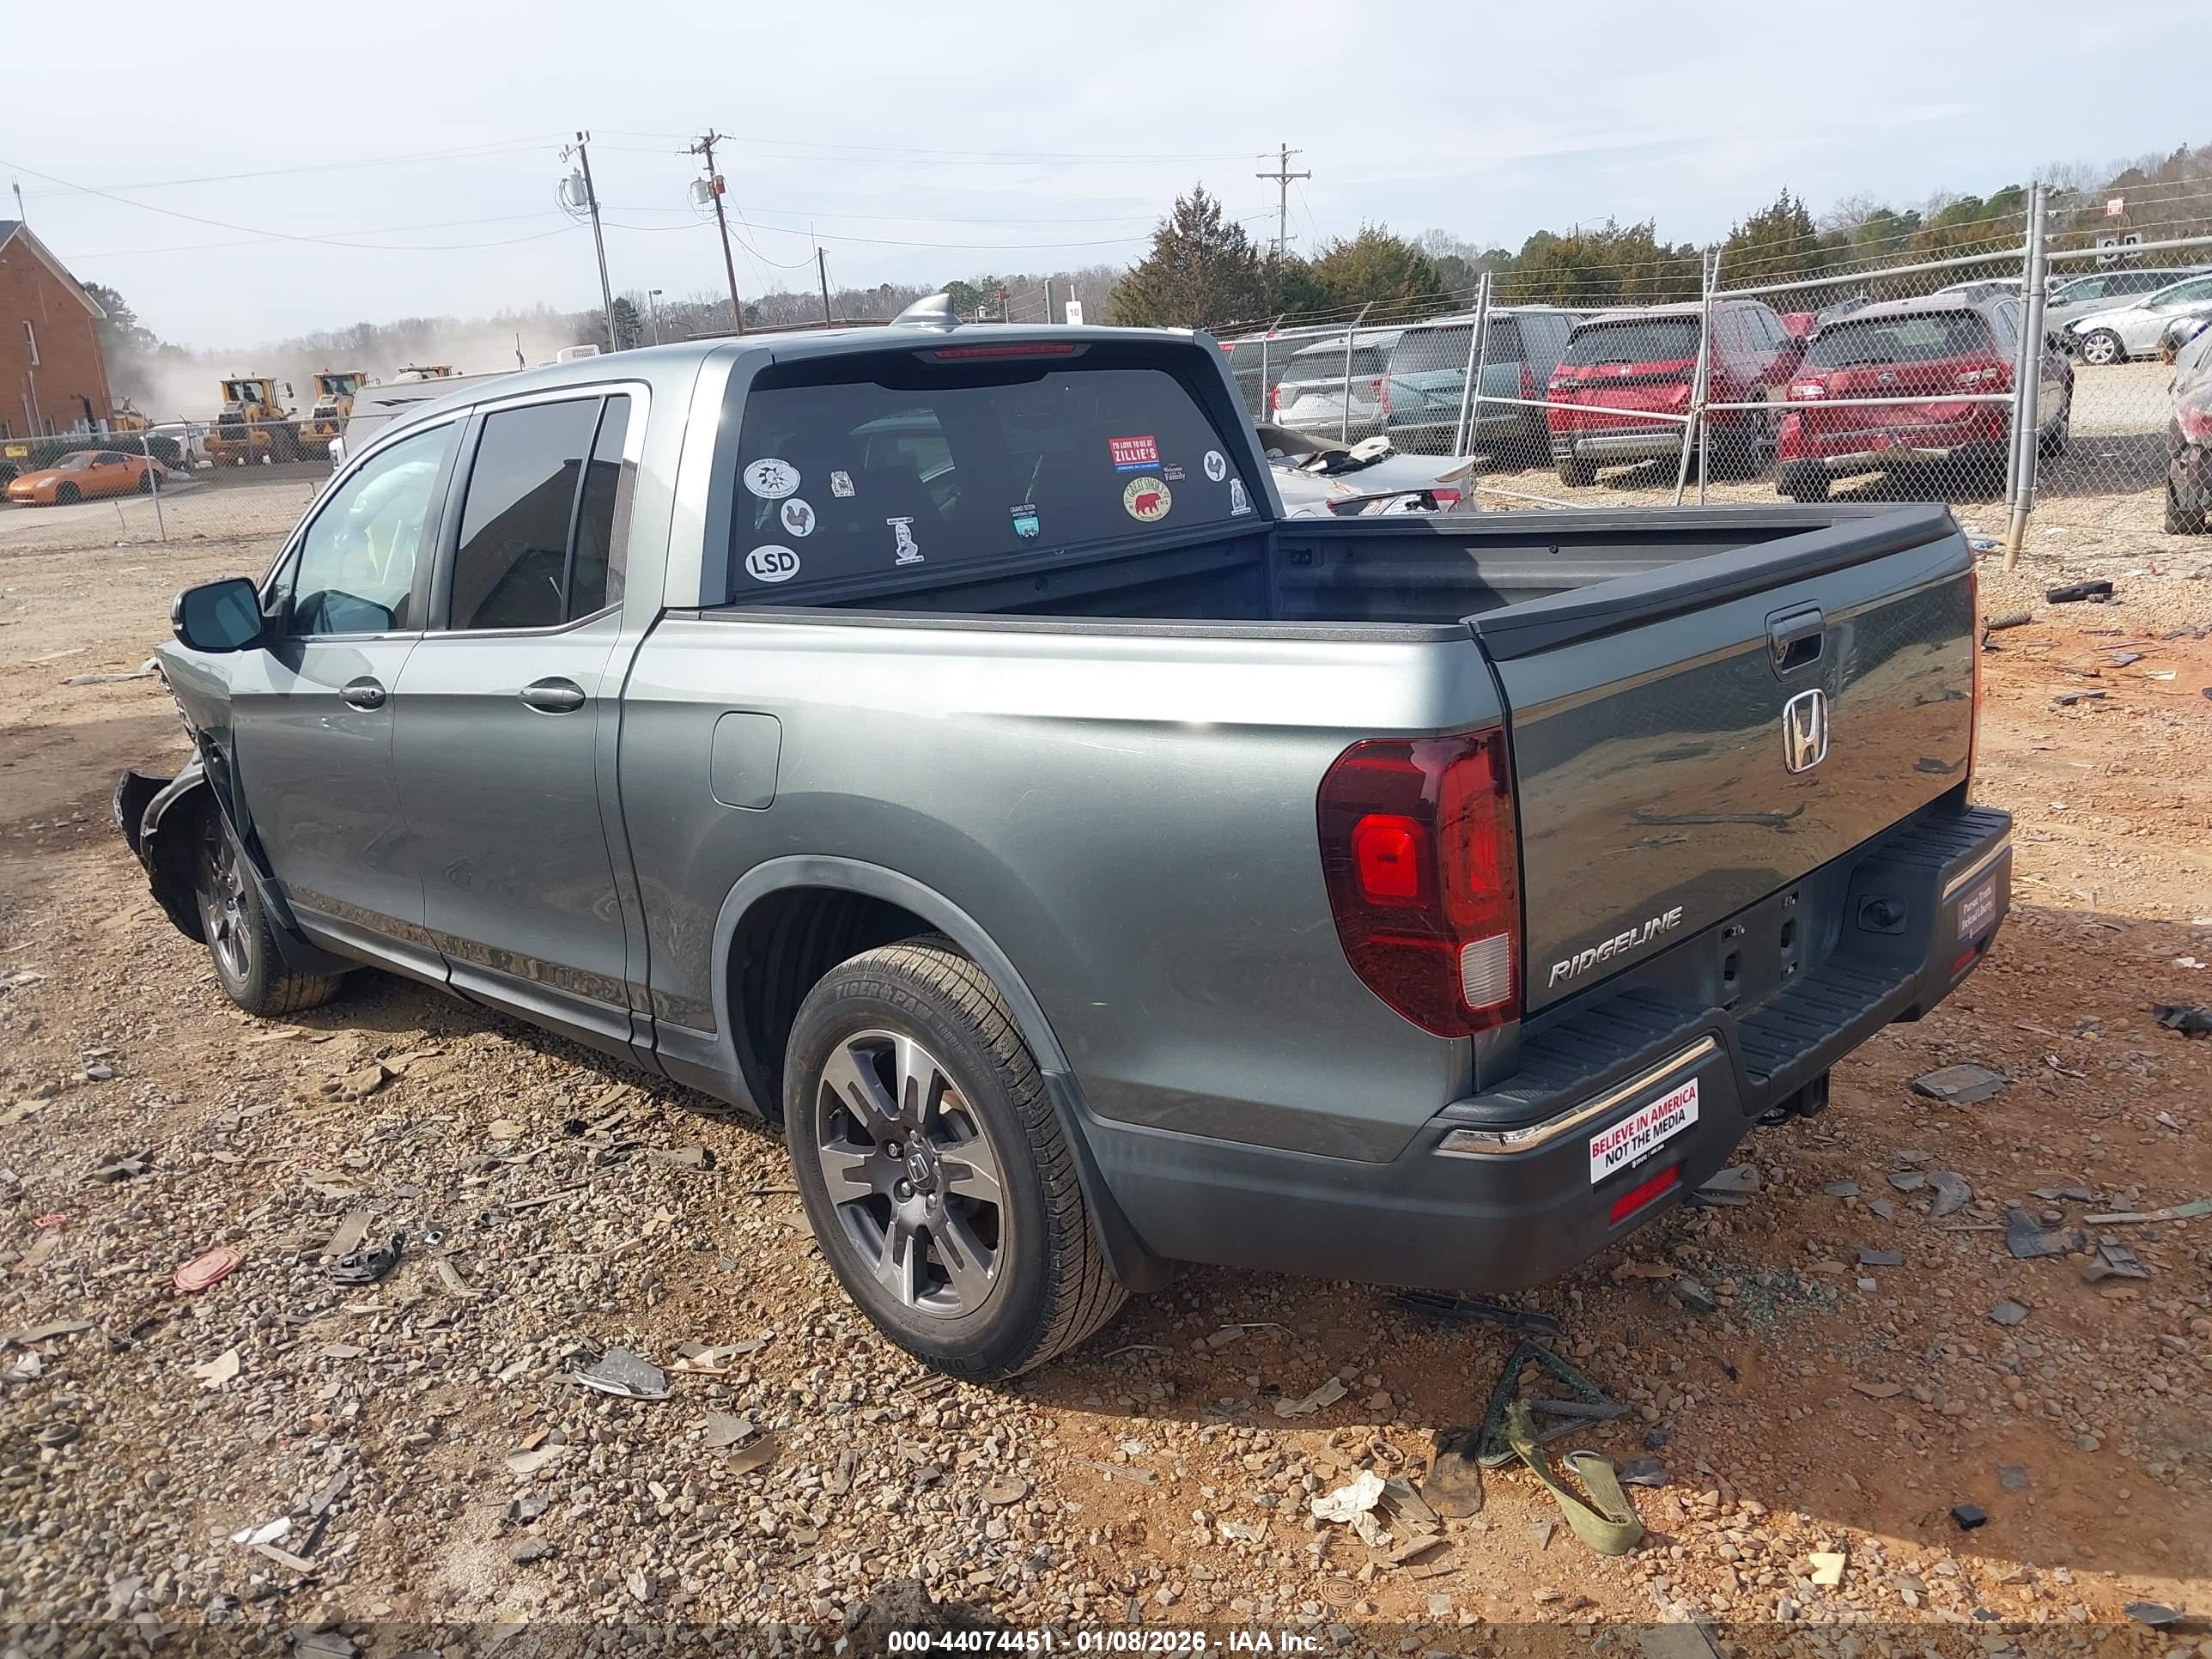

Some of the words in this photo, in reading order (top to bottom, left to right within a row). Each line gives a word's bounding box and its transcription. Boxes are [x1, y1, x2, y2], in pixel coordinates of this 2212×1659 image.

[1070, 308, 1079, 317] 10
[1115, 448, 1156, 462] ZILLIE'S
[1126, 479, 1145, 497] GREAT
[1144, 478, 1166, 494] SMOKY
[751, 551, 795, 574] LSD
[1978, 885, 1992, 902] Truth
[1548, 905, 1683, 988] RIDGELINE
[836, 981, 880, 1000] TIGER
[892, 990, 935, 1020] PAW
[1591, 1121, 1635, 1158] BELIEVE
[1637, 1113, 1649, 1133] IN
[1650, 1085, 1697, 1124] AMERICA
[1605, 1141, 1630, 1169] NOT
[1631, 1128, 1650, 1152] THE
[1653, 1108, 1686, 1139] MEDIA
